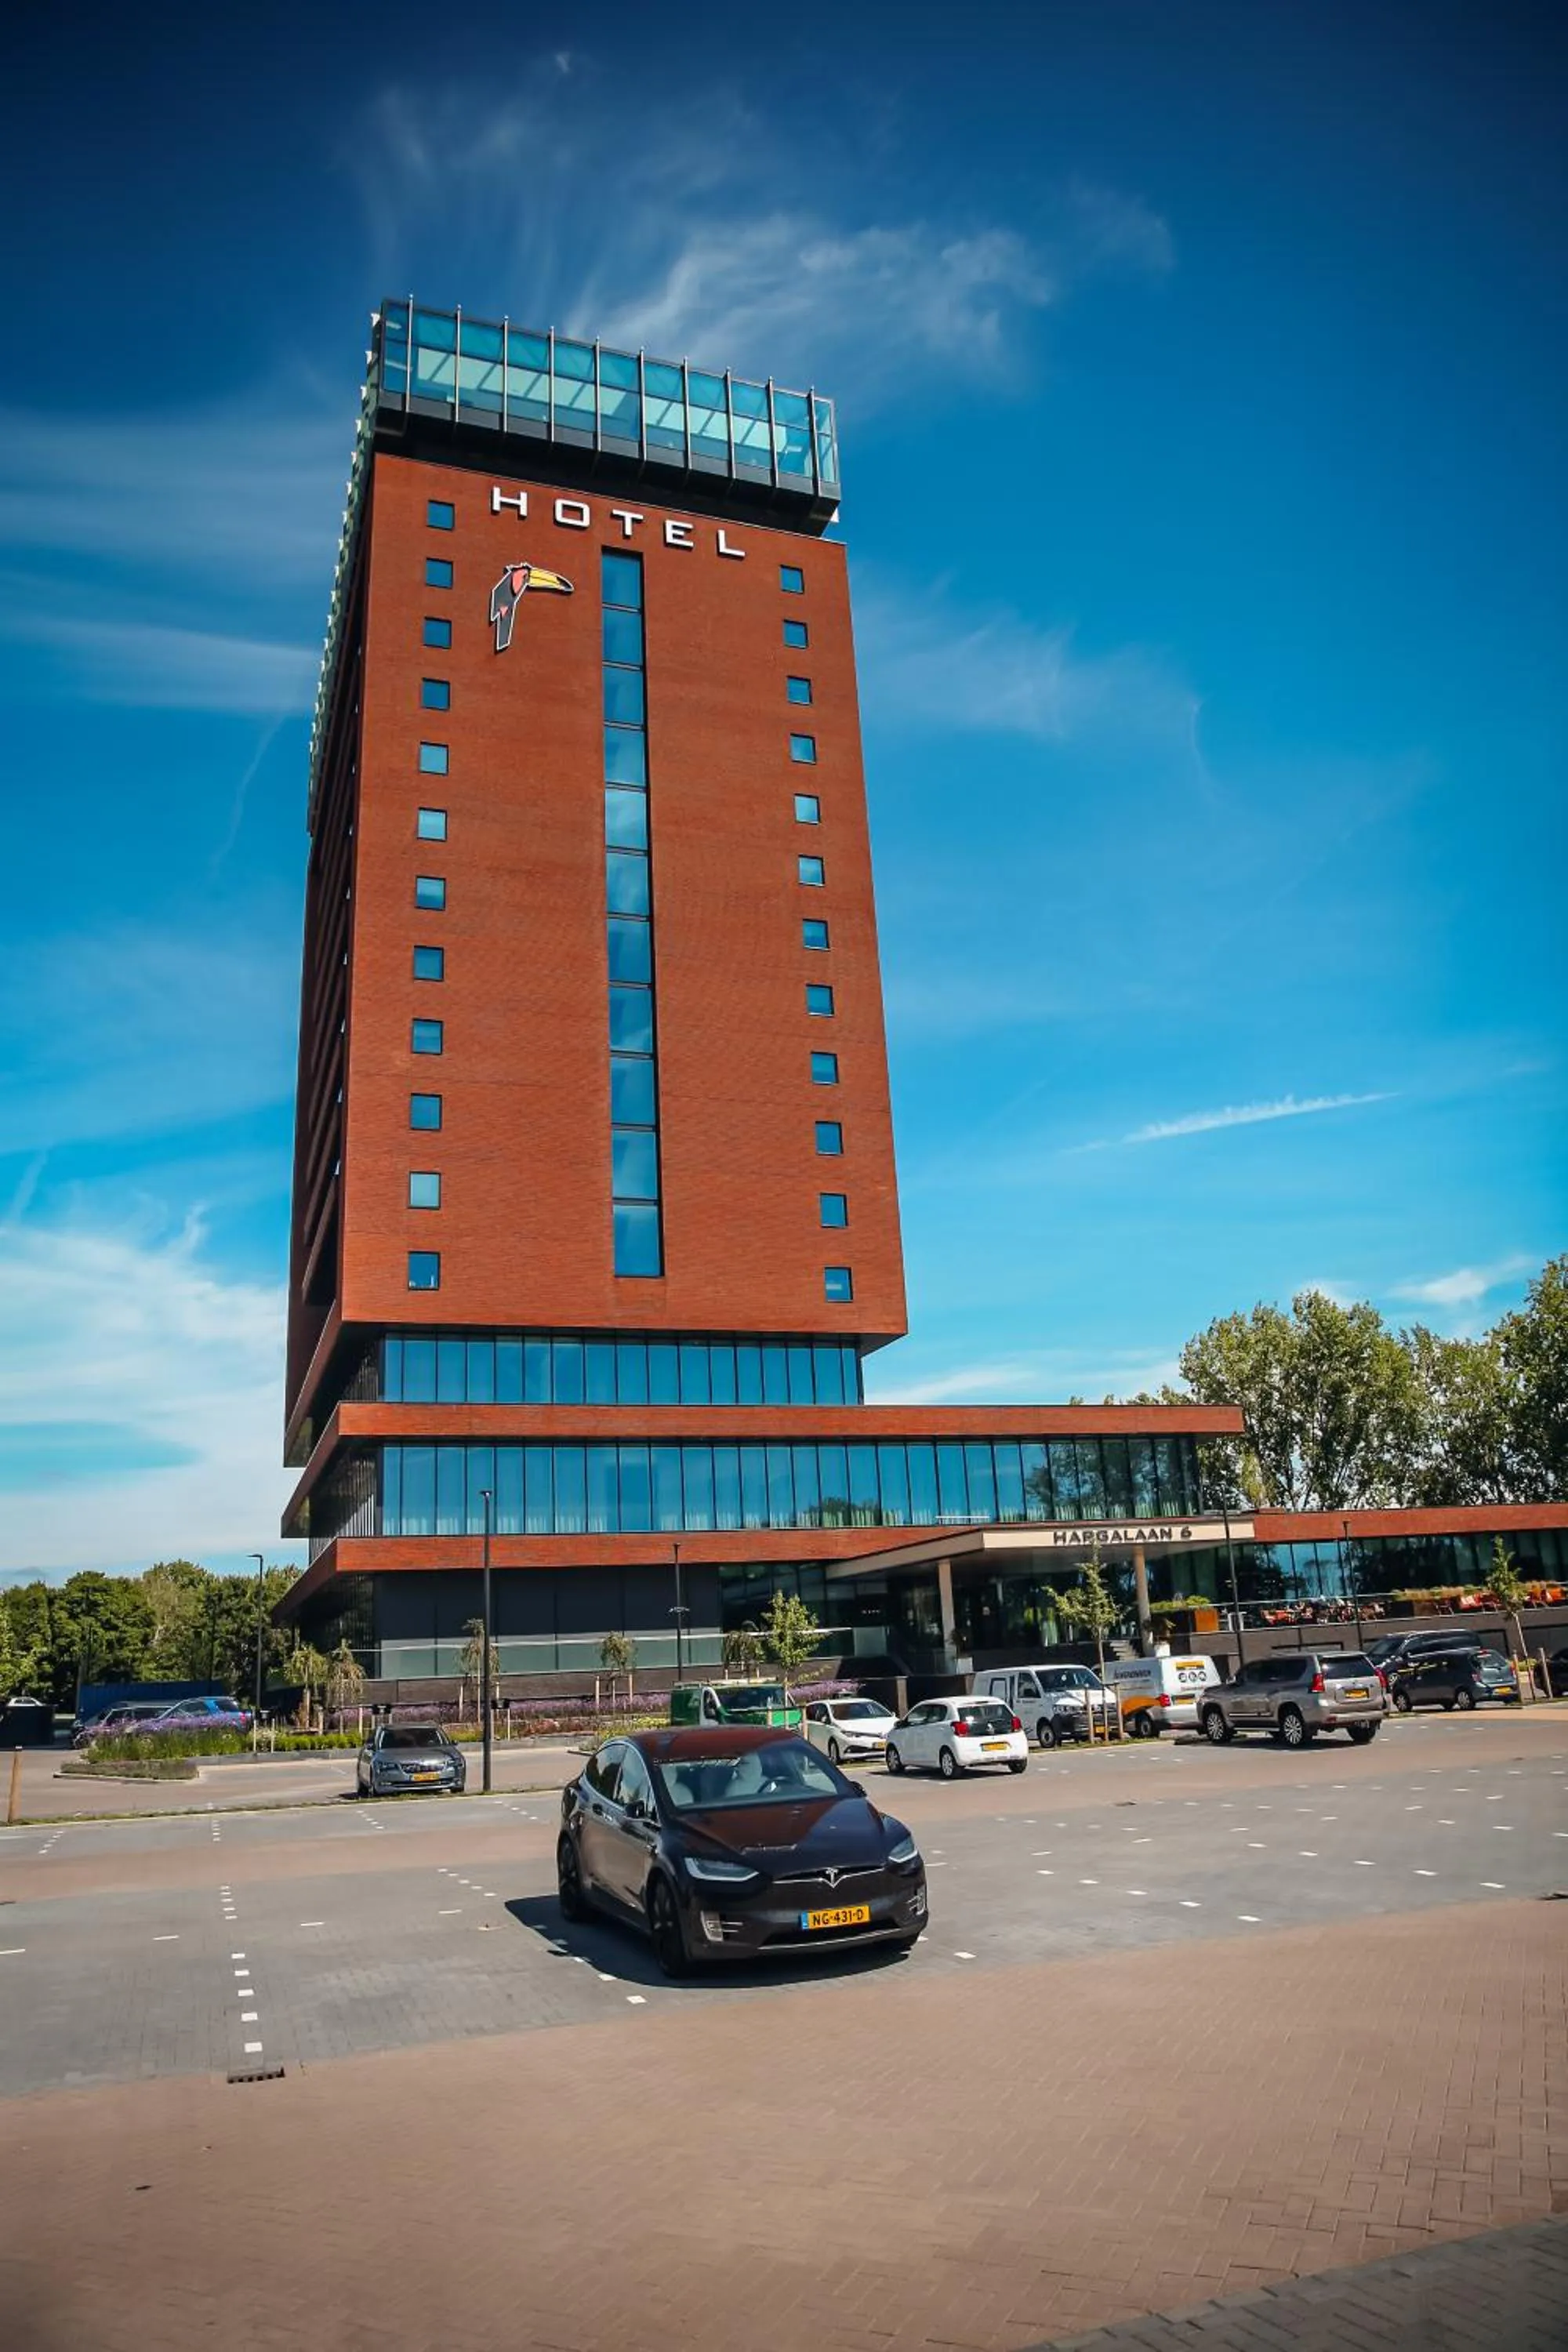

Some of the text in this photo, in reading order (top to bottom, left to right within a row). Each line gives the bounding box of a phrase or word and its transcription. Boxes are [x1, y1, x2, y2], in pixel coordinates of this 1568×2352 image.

[491, 486, 746, 558] HOTEL
[1180, 1526, 1192, 1541] 6
[812, 1908, 864, 1926] NG-431-D
